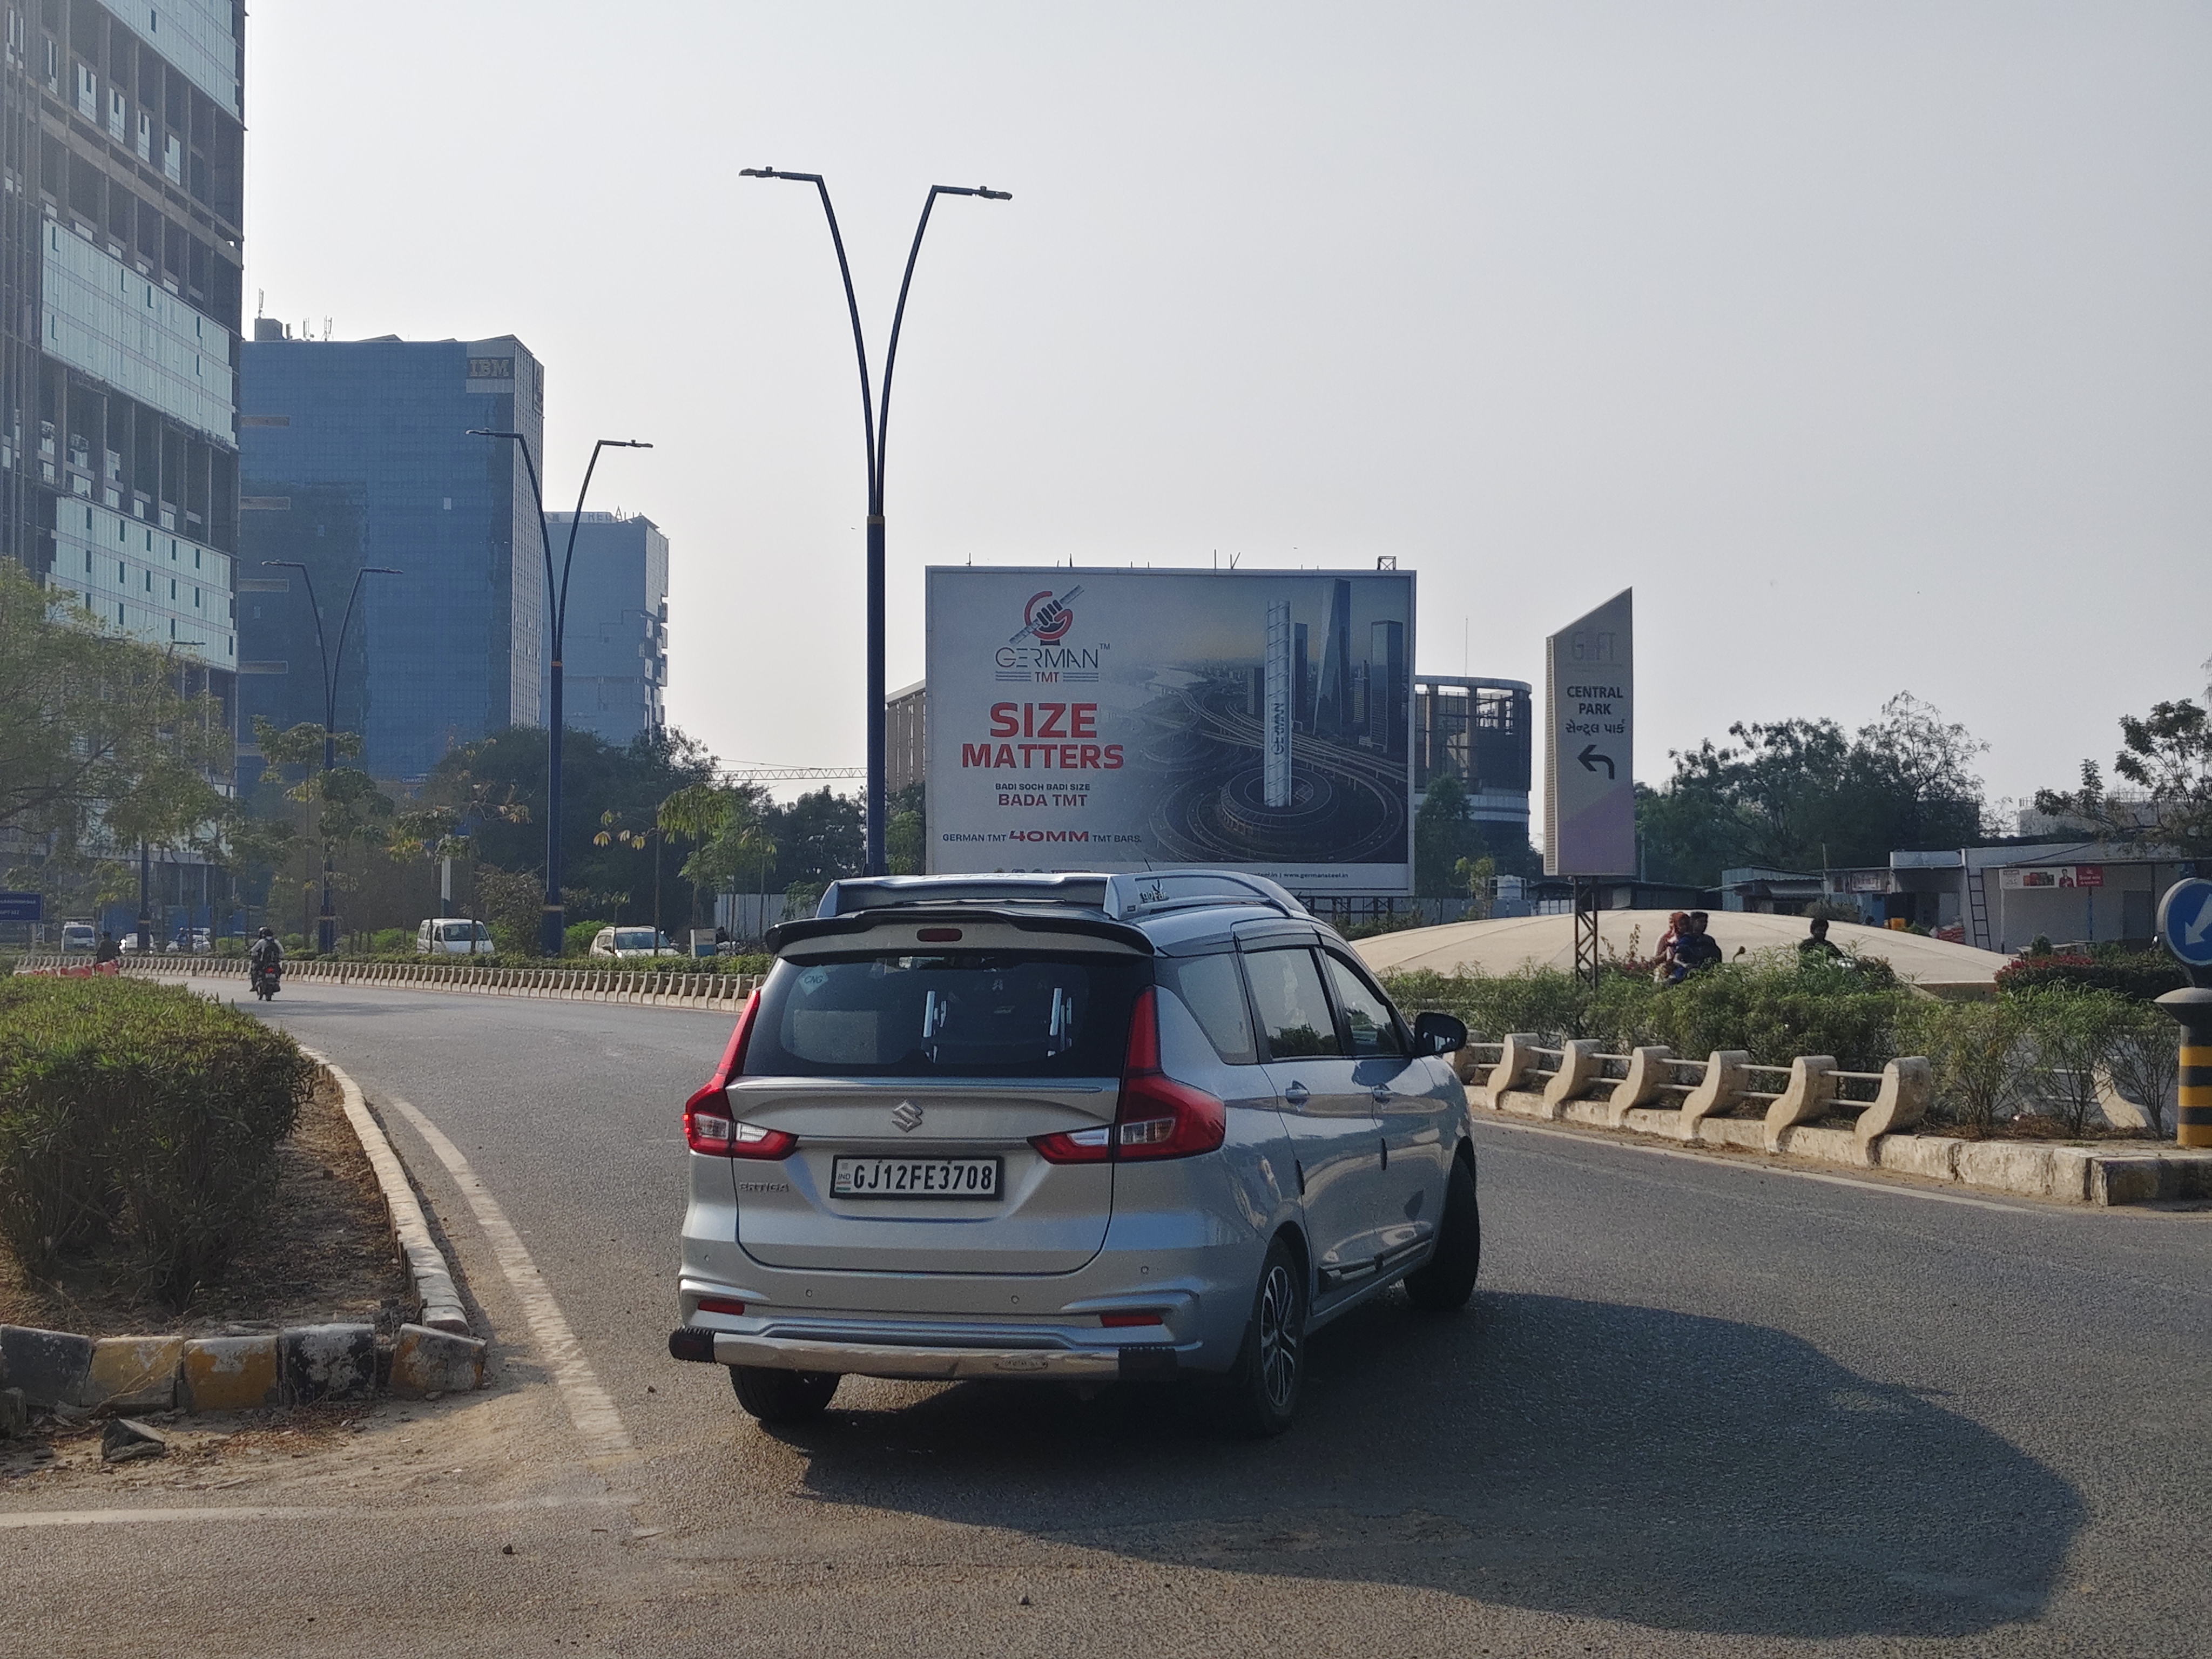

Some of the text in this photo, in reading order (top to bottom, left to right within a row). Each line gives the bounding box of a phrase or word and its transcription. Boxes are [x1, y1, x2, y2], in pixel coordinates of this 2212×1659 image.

[470, 359, 509, 376] IBM
[995, 647, 1098, 669] GERMAN
[1035, 671, 1060, 683] TMT
[1567, 685, 1624, 698] CENTRAL
[1579, 703, 1611, 714] PARK
[990, 702, 1097, 738] SIZE
[1604, 718, 1626, 734] પાર્ક
[1272, 703, 1285, 755] GERMAN
[962, 743, 1124, 770] MATTERS
[1019, 783, 1044, 791] SOCH
[998, 793, 1088, 806] BADA TMT
[942, 834, 986, 842] GERMAN
[987, 834, 1007, 842] TMT
[1092, 834, 1112, 843] TMT
[804, 975, 824, 984] CNG
[853, 1164, 993, 1190] GJ12FE3708
